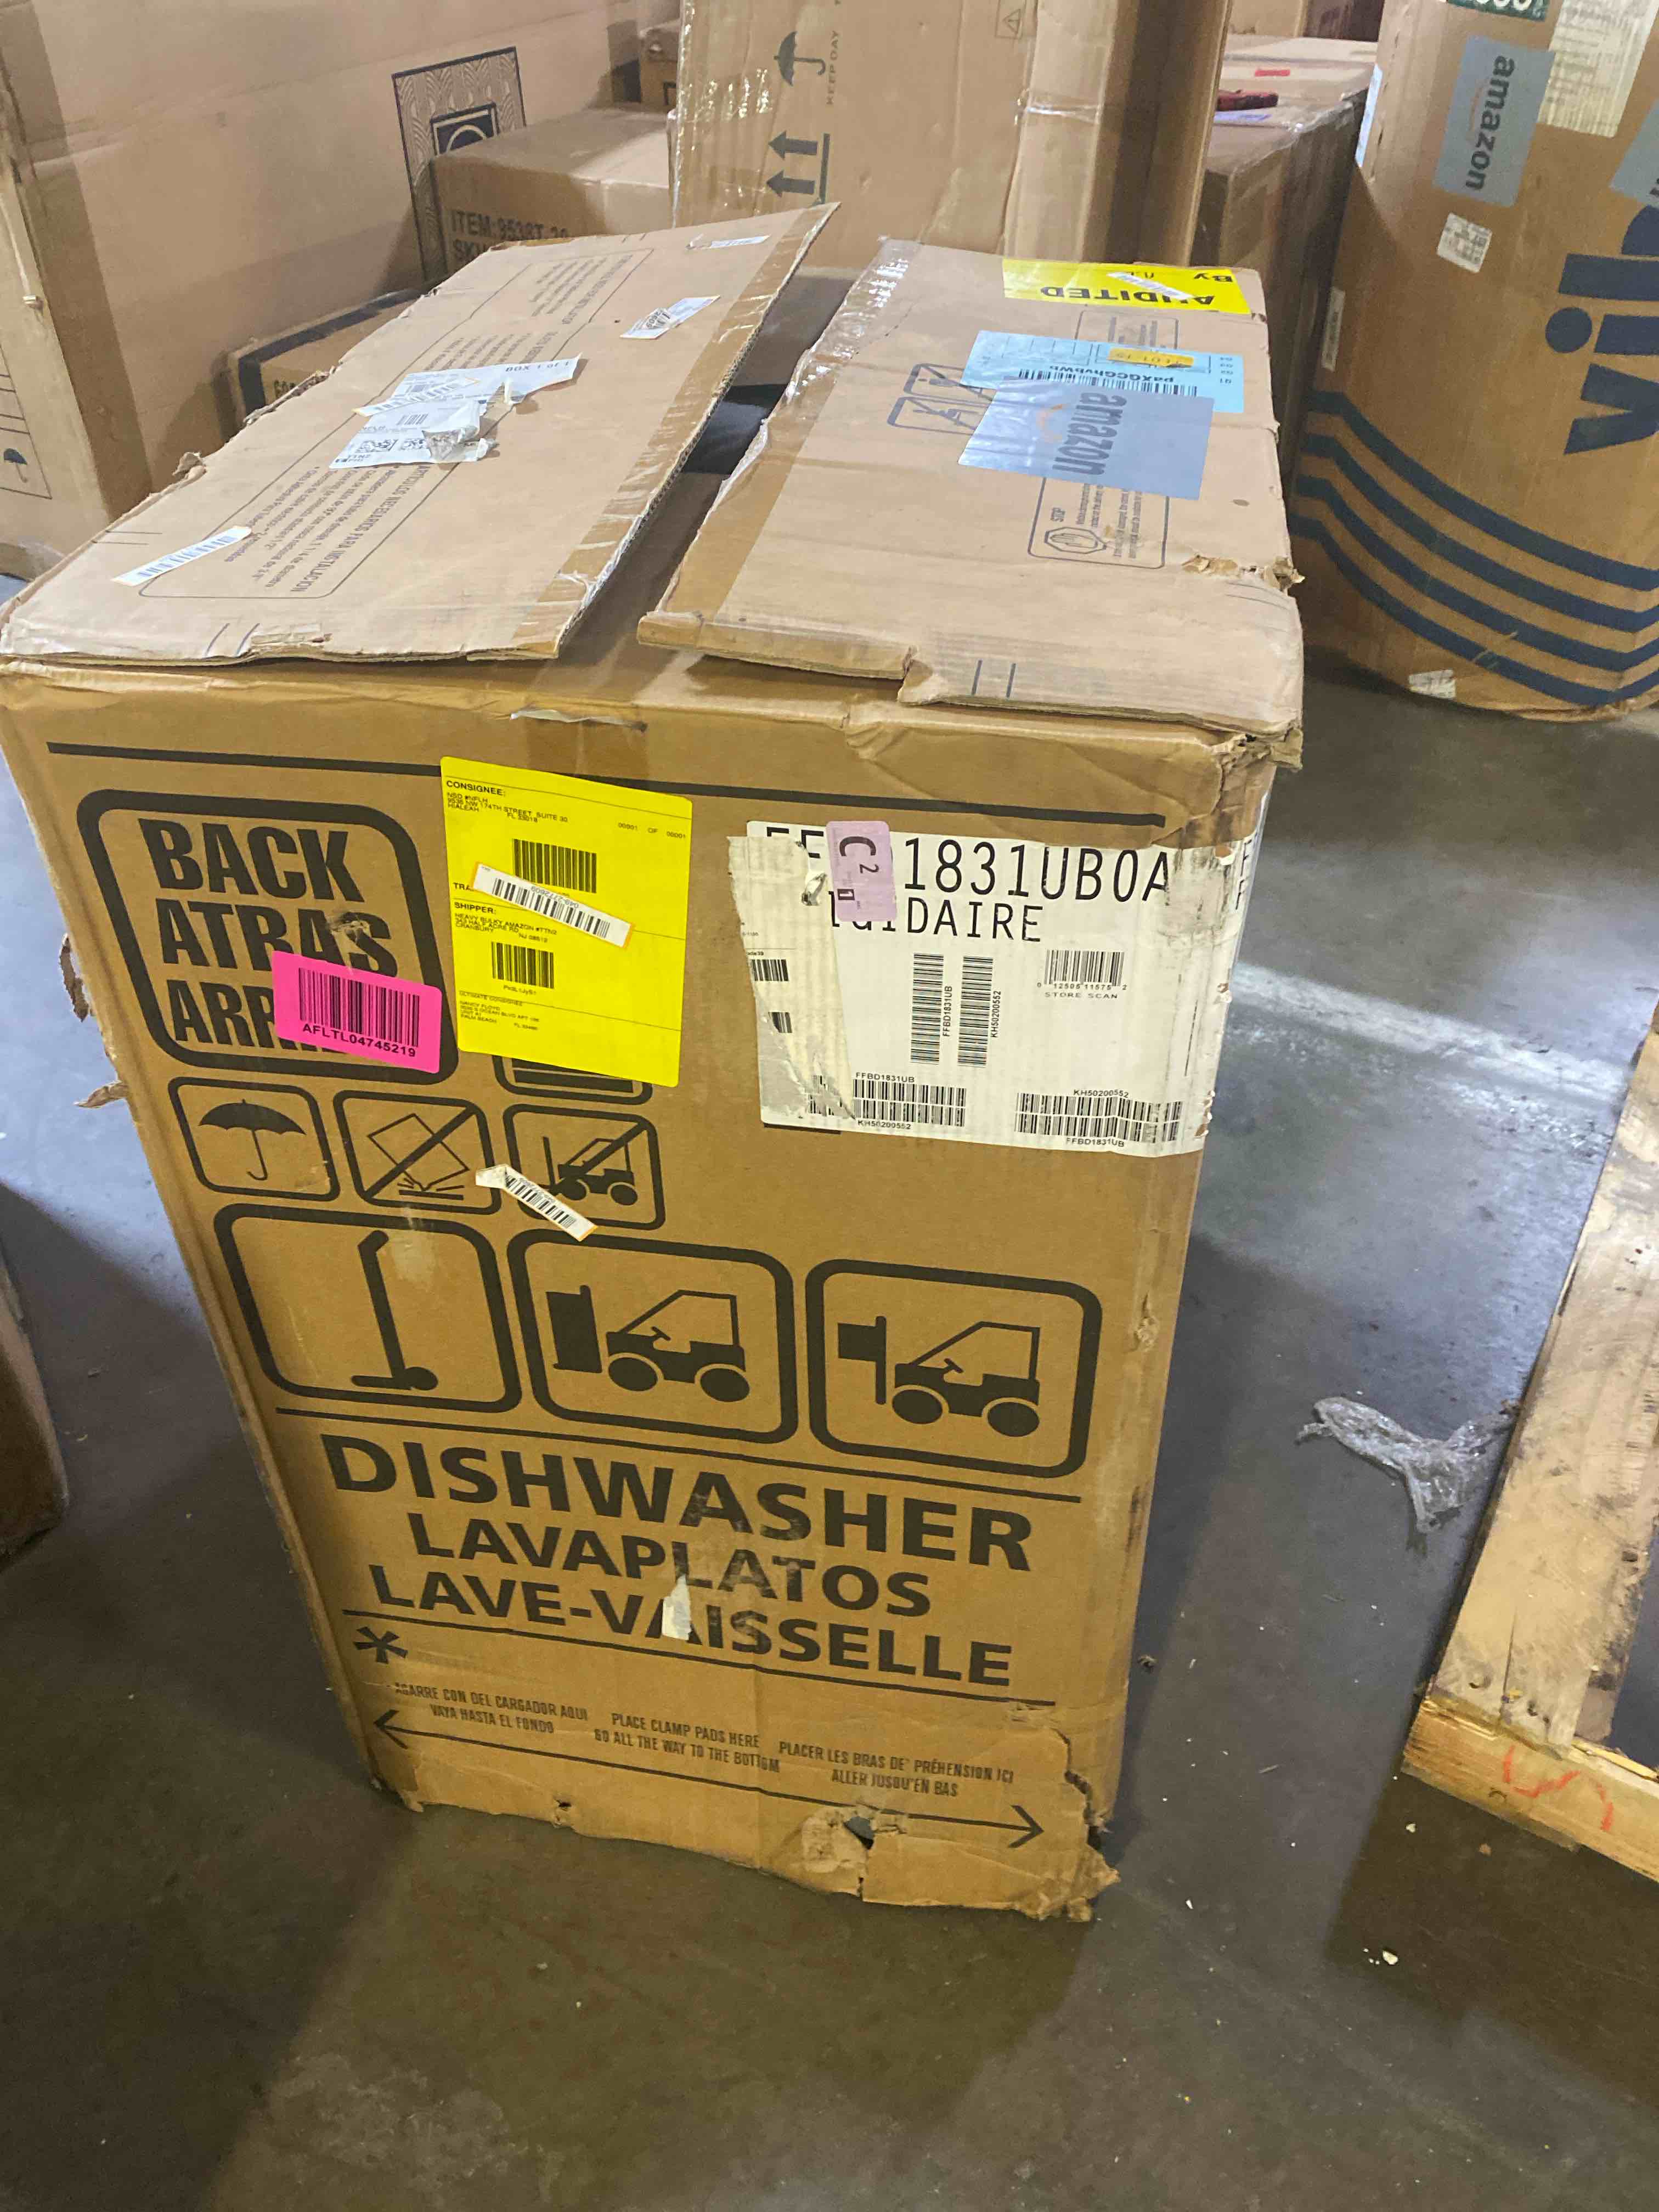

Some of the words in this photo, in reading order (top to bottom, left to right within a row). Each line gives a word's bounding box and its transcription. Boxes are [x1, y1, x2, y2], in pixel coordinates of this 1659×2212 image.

[1465, 55, 1515, 191] amazon
[1052, 392, 1127, 475] amazon
[336, 533, 363, 549] PARA
[447, 781, 505, 797] CONSIGNEE:
[448, 803, 479, 812] HIALEAH
[481, 803, 501, 811] 174TH
[504, 807, 532, 816] STREET
[537, 812, 557, 820] SUITE
[138, 818, 364, 902] BACK
[839, 836, 877, 857] C
[859, 864, 879, 873] 2
[454, 902, 496, 914] SHIPPER:
[455, 913, 478, 921] HEAVY
[480, 917, 503, 925] BULKY
[505, 921, 534, 931] AMAZON
[155, 898, 398, 977] ATRAS
[455, 922, 494, 933] CRANBURY
[489, 924, 506, 932] ACRE
[943, 986, 953, 1037] FFBD1831UB
[991, 991, 1002, 1037] KH50200552
[302, 1024, 416, 1057] AFLTL04745219
[856, 1072, 915, 1083] FFBD1831UB
[1074, 1089, 1128, 1098] KH50200552
[1066, 1137, 1125, 1147] FFBD1831UB
[320, 1434, 1032, 1571] DISHWASHER
[408, 1512, 930, 1617] LAVAPLATOS
[443, 1689, 467, 1703] CON
[470, 1692, 492, 1707] DEL
[495, 1696, 556, 1716] CARGADOR
[561, 1705, 588, 1720] AQUI
[430, 1704, 456, 1718] VAYA
[461, 1708, 496, 1725] HASTA
[499, 1714, 512, 1728] EL
[516, 1716, 554, 1734] FONDO
[611, 1712, 646, 1730] PLACE
[651, 1719, 691, 1737] CLAMP
[695, 1726, 725, 1743] PADS
[729, 1732, 760, 1748] HERE
[594, 1729, 610, 1743] GO
[614, 1731, 634, 1747] ALL
[637, 1735, 658, 1751] THE
[662, 1739, 686, 1755] WAY
[690, 1744, 705, 1758] TO
[708, 1747, 729, 1763] THE
[733, 1751, 781, 1773] BOTTOM
[778, 1741, 824, 1760] PLACER
[828, 1748, 849, 1764] LES
[853, 1753, 886, 1769] BRAS
[831, 1769, 868, 1786] ALLER
[934, 1780, 957, 1797] BAS
